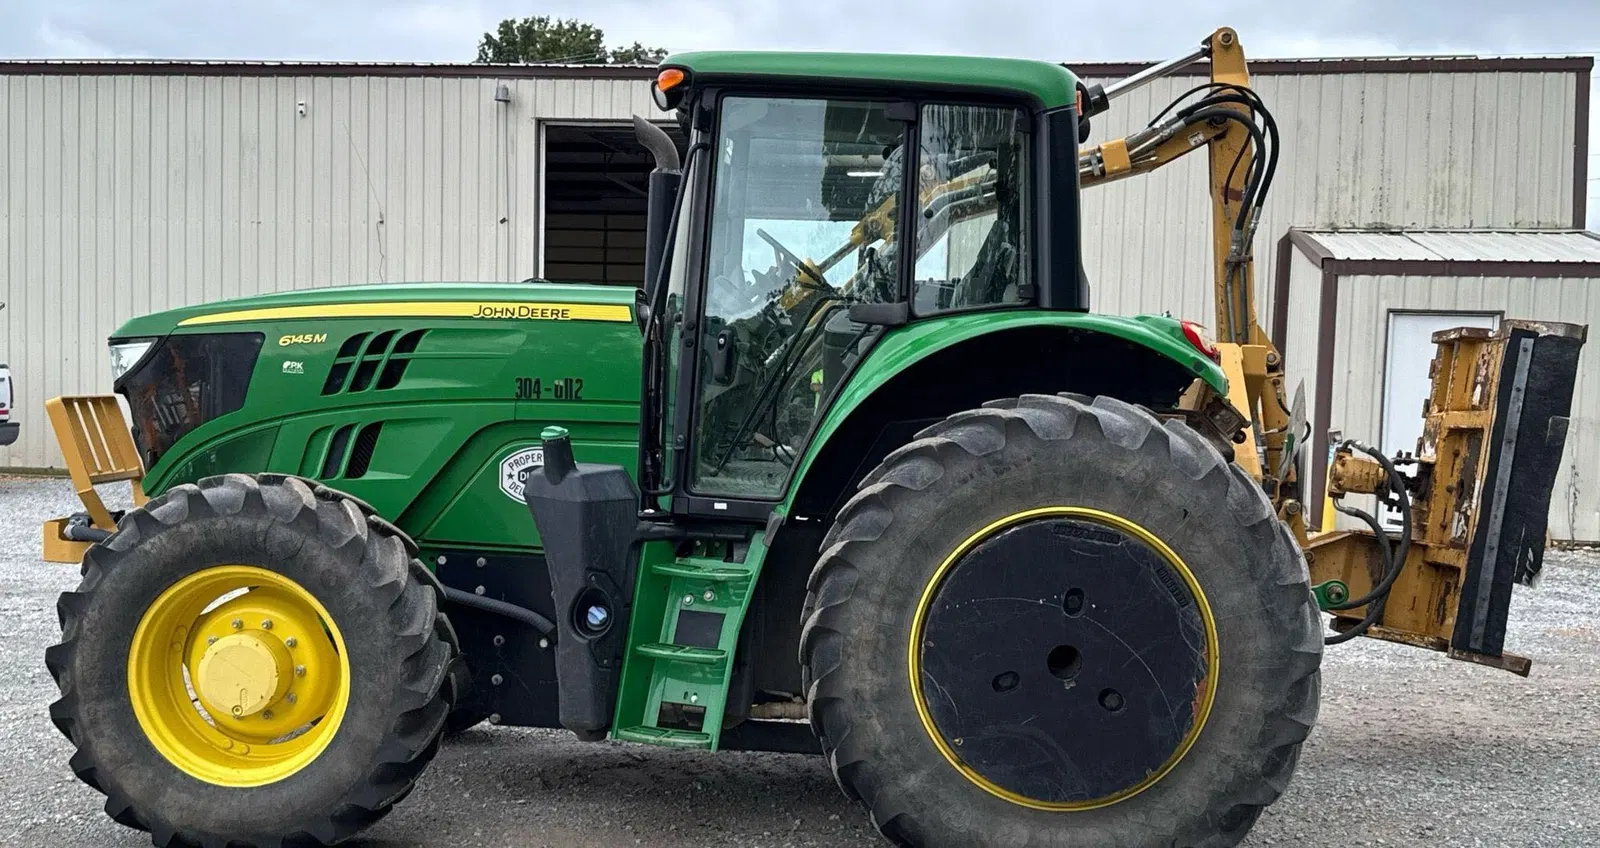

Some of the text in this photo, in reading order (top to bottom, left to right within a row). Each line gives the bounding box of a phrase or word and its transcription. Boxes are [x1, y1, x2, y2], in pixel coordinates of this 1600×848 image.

[473, 305, 570, 318] JOHN DEERE
[279, 333, 328, 346] 6145M
